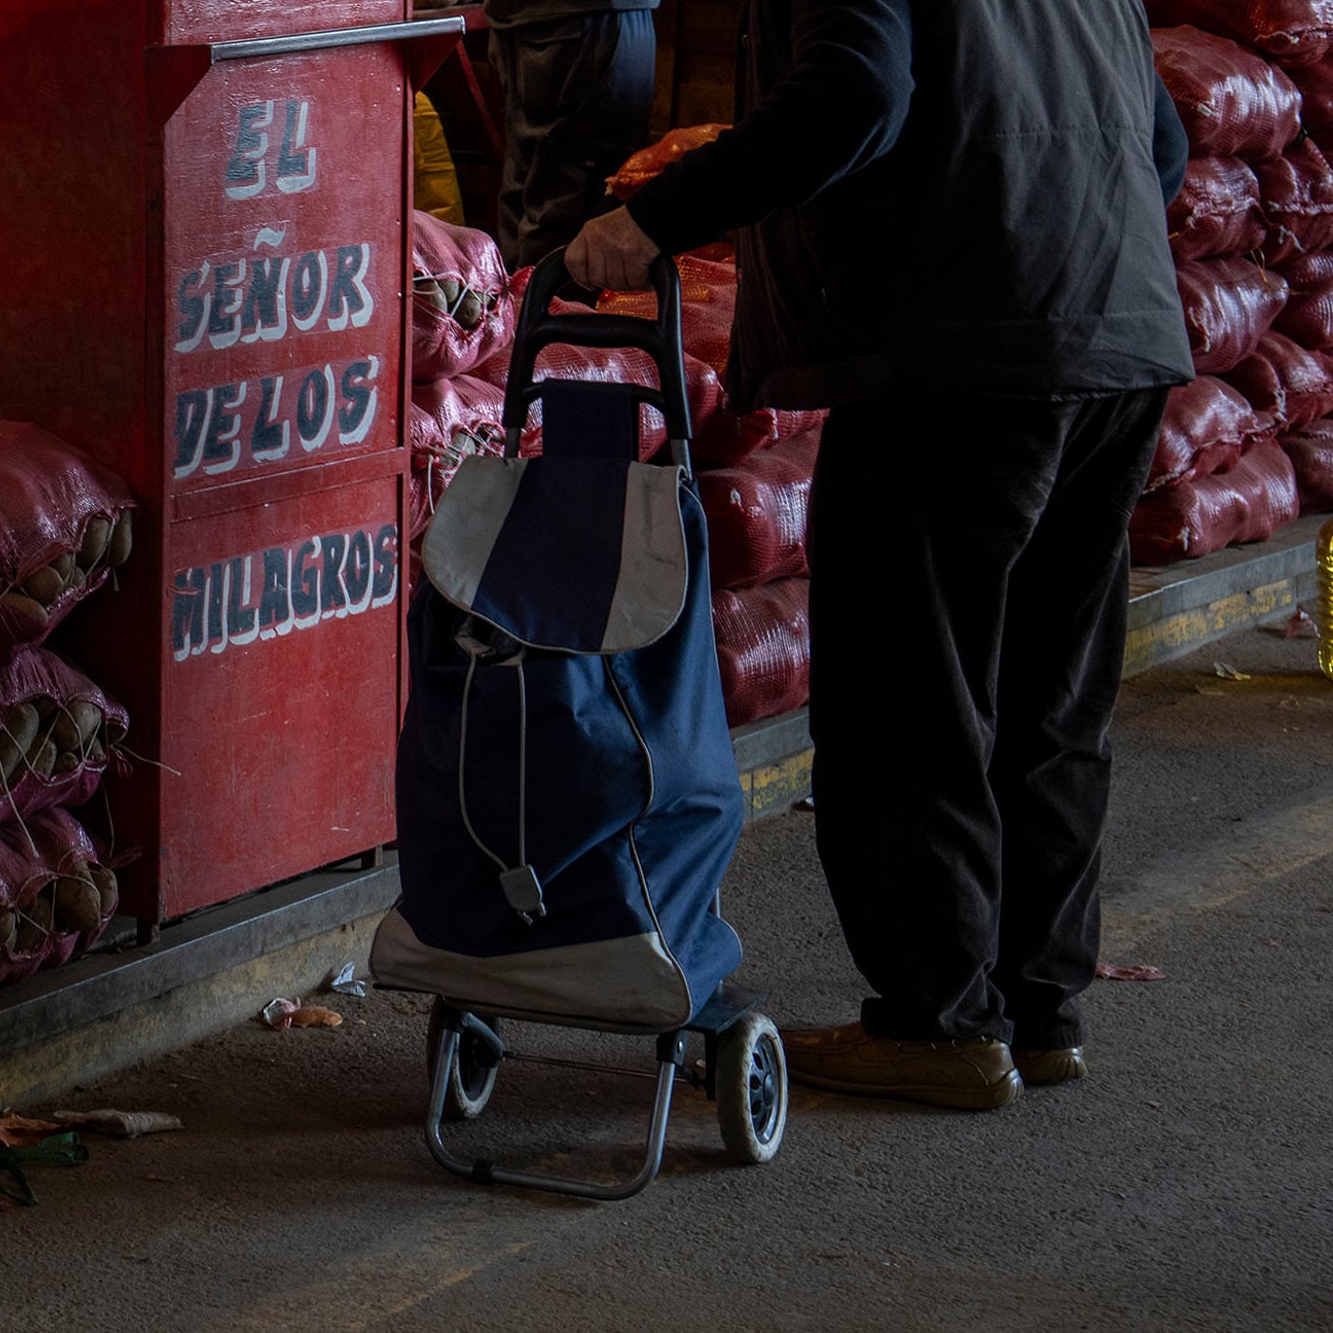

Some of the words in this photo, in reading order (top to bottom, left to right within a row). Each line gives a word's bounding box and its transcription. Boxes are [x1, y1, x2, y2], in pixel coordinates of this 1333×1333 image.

[225, 99, 317, 200] EL
[173, 224, 374, 353] SEÑOR
[173, 380, 248, 479] DE
[250, 354, 380, 462] LOS
[171, 523, 399, 662] MILAGROS
